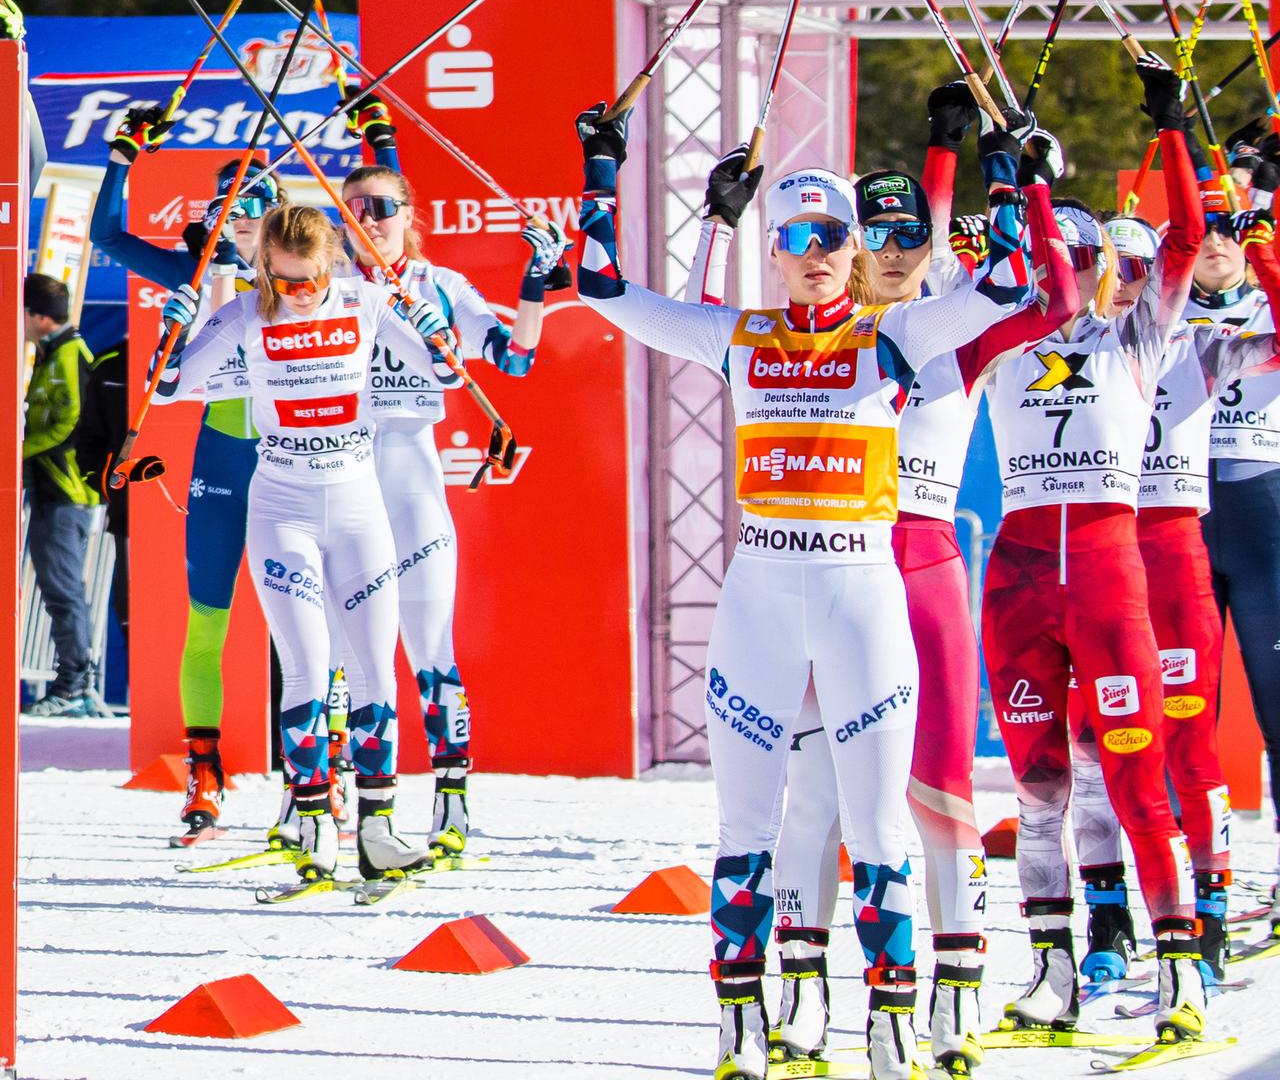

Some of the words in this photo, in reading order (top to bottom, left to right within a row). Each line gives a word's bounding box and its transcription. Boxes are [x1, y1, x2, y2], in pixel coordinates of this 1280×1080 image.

[266, 327, 357, 351] bett1.de
[286, 360, 345, 373] Deutschlands
[753, 358, 851, 378] bett1.de
[764, 392, 830, 404] Deutschlands
[1020, 395, 1099, 408] AXELENT
[746, 407, 807, 421] meistgekaufte
[811, 407, 855, 419] Matratze
[266, 426, 372, 452] SCHONACH
[1045, 409, 1073, 448] 7
[742, 447, 862, 482] VIESSMANN
[1009, 450, 1119, 473] SCHONACH
[767, 497, 811, 506] COMBINED
[814, 497, 846, 507] WORLD
[739, 522, 866, 553] SCHONACH
[345, 569, 392, 611] CRAFT
[1102, 684, 1130, 702] Stiegl
[728, 695, 784, 740] OBOS
[836, 694, 898, 744] CRAFT
[1003, 709, 1054, 724] Löffler
[730, 719, 773, 752] Watne
[1107, 730, 1150, 746] Recheis
[1012, 1033, 1056, 1044] FISCHER
